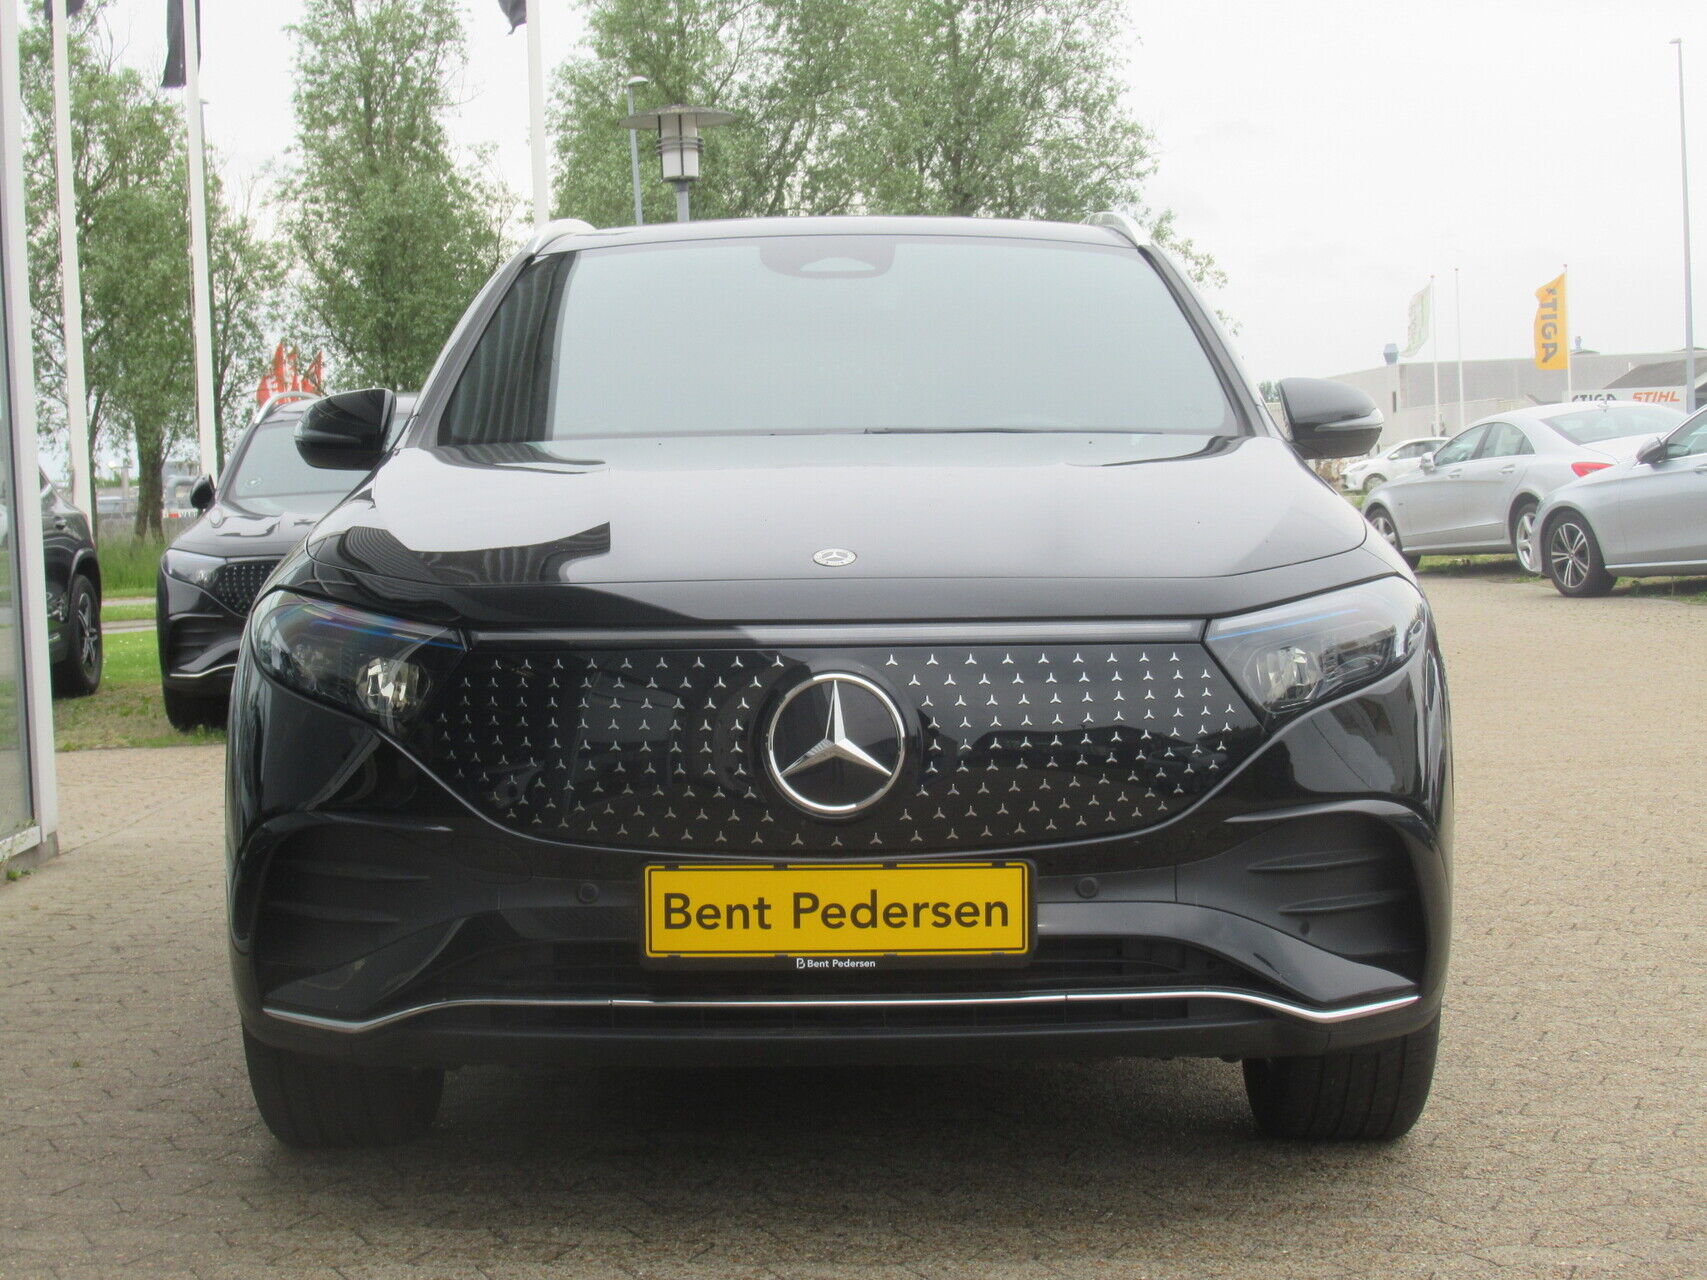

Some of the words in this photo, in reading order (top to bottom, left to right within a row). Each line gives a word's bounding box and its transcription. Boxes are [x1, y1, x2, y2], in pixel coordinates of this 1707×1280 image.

[1632, 391, 1680, 403] STIHL
[663, 892, 772, 930] Bent
[793, 889, 1009, 929] Pedersen
[807, 959, 829, 968] Bent
[832, 958, 876, 968] Pedersen
